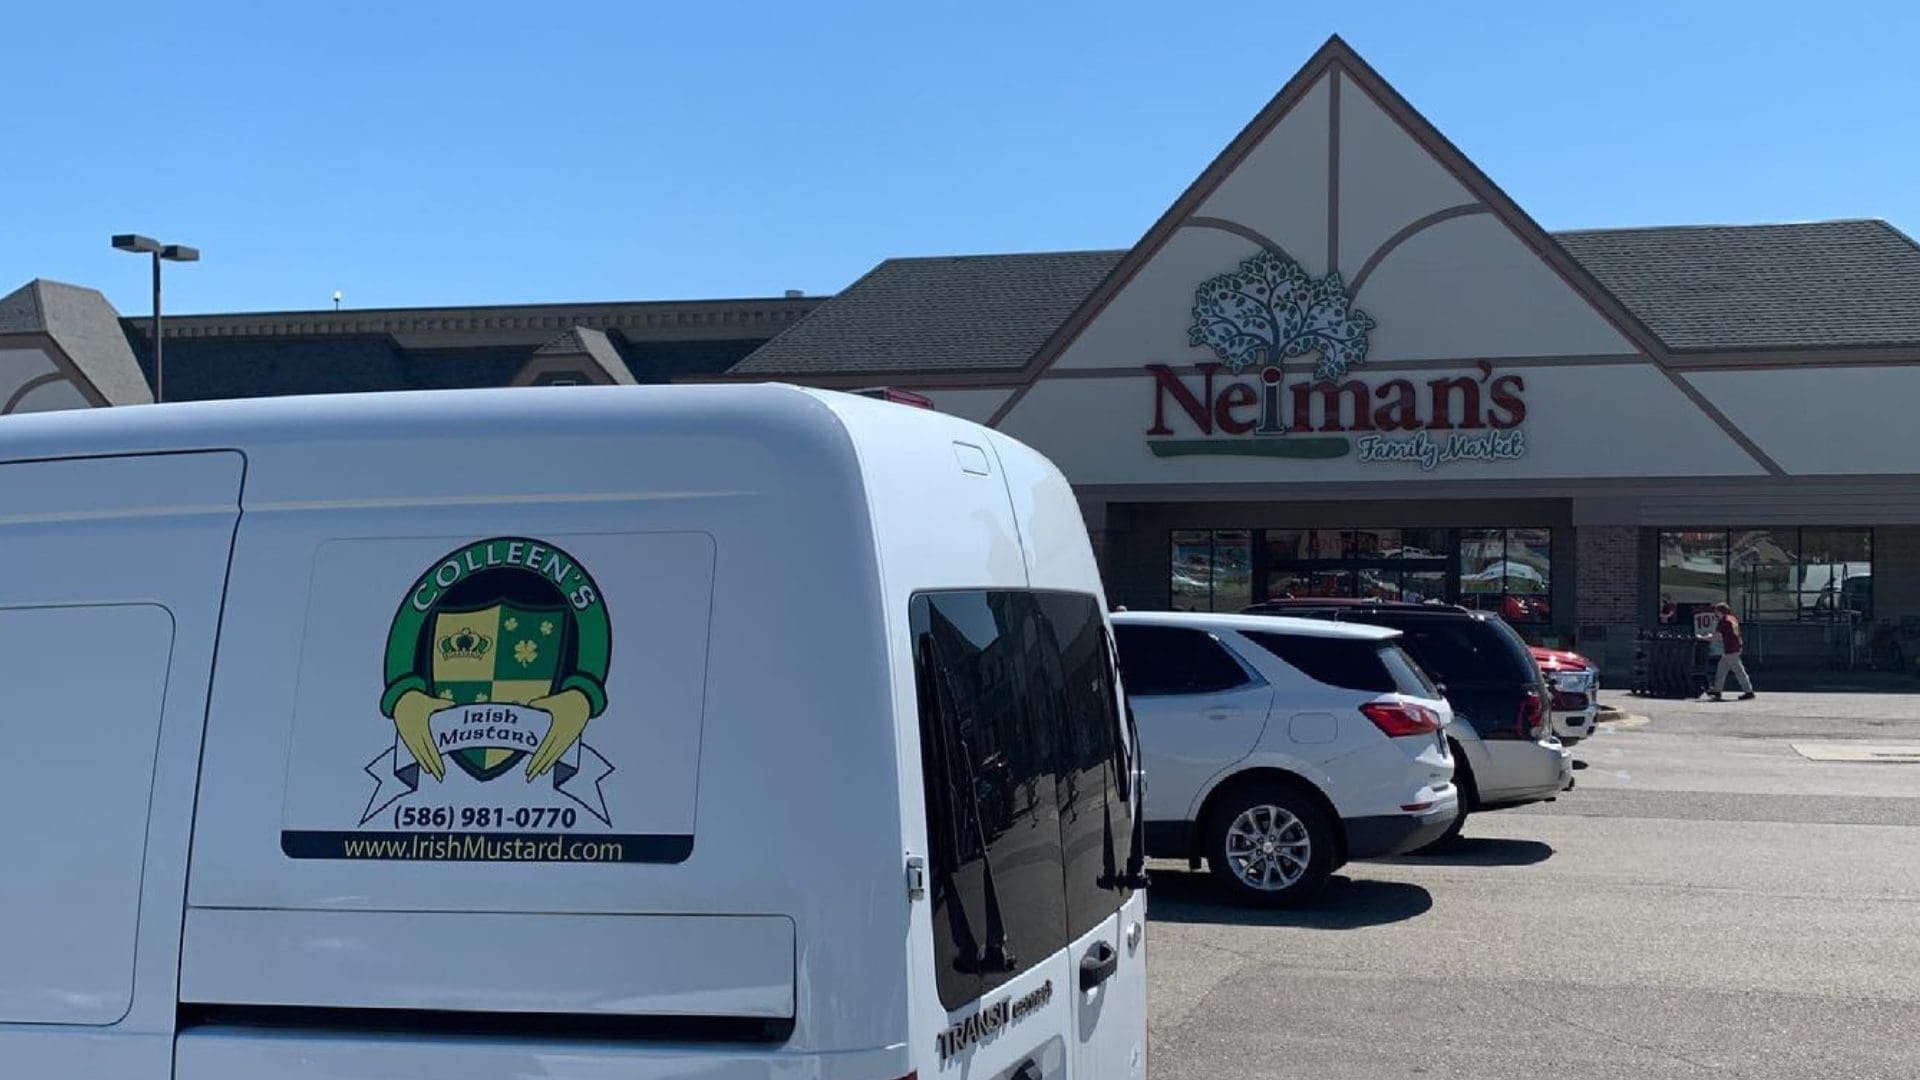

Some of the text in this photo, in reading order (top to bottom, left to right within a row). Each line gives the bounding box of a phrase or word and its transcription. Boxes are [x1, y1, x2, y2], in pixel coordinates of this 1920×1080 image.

[1146, 360, 1527, 436] Neiman's
[1357, 430, 1524, 472] Family Market
[411, 540, 597, 612] COLLEEN'S
[463, 707, 518, 726] Irish
[438, 725, 539, 748] Mustard
[394, 806, 577, 830] (586) 981-0770
[344, 835, 623, 863] www.IrishMustard.com
